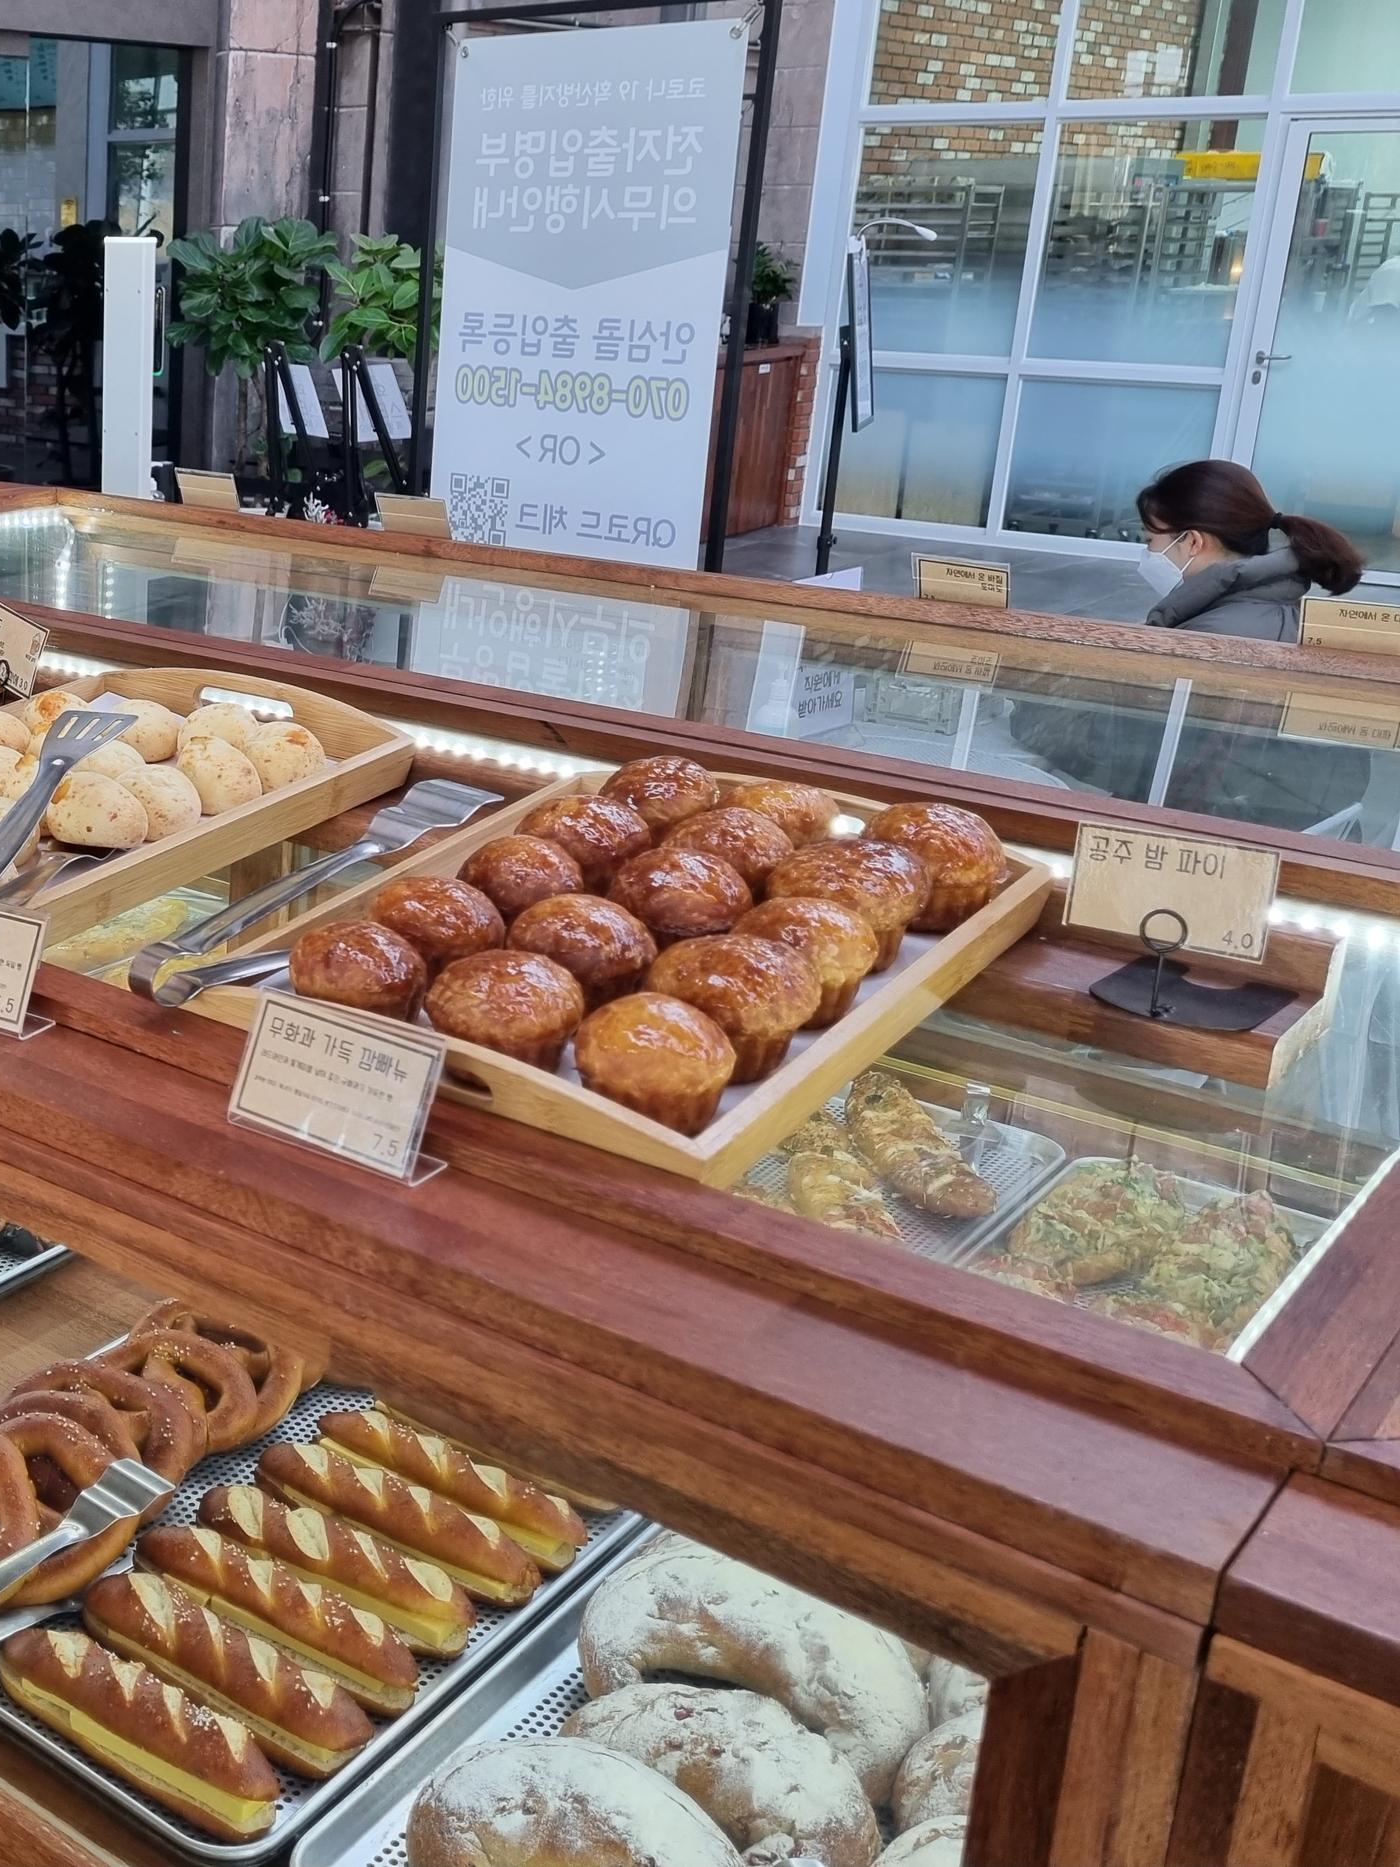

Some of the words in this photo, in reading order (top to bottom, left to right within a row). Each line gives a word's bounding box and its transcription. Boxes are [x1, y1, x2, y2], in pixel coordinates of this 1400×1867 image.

[946, 567, 976, 580] 자연에서
[1338, 608, 1378, 622] 자연에서
[1381, 612, 1391, 622] 온
[798, 690, 843, 719] 받아가세요
[1089, 835, 1134, 865] 공주
[1144, 843, 1168, 871] 밤
[1176, 848, 1226, 879] 파이
[1222, 930, 1253, 950] 4.0
[269, 1016, 316, 1048] 무화과
[324, 1034, 355, 1065] 가득
[358, 1047, 408, 1083] 깜빠뉴
[372, 1133, 399, 1158] 7.5
